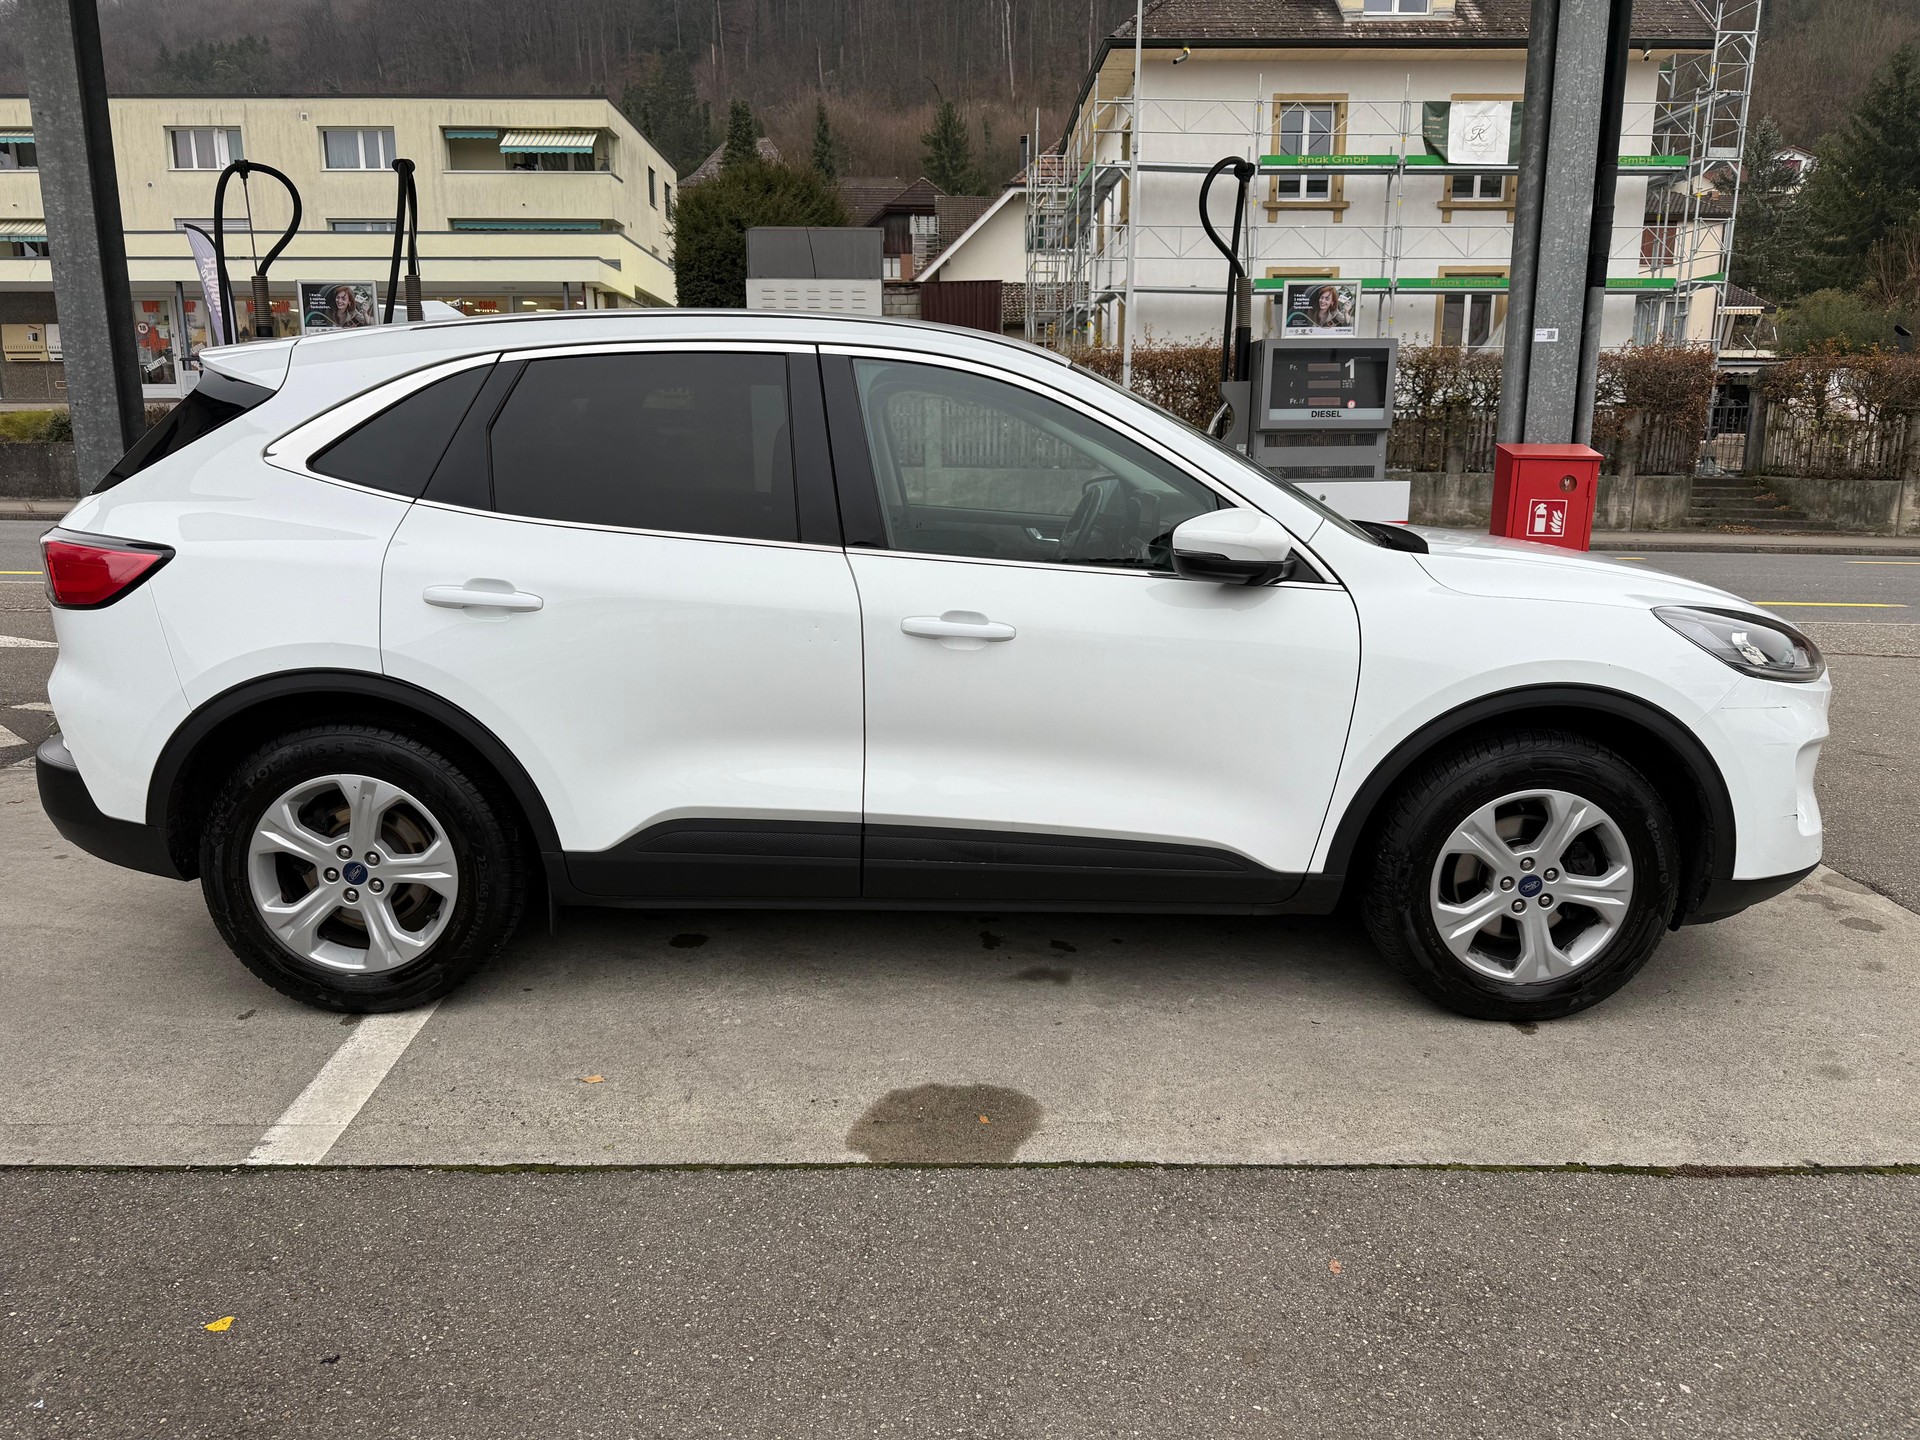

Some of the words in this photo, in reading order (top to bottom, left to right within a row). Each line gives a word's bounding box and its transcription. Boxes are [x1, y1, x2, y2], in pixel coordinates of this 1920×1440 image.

[1297, 156, 1329, 164] Rinak
[1332, 156, 1369, 164] GmbH
[1618, 156, 1655, 165] GmbH
[1431, 279, 1461, 287] Rinak
[1464, 279, 1501, 287] GmbH
[1606, 279, 1643, 287] GmbH
[1345, 358, 1356, 379] 1
[1311, 410, 1342, 418] DIESEL
